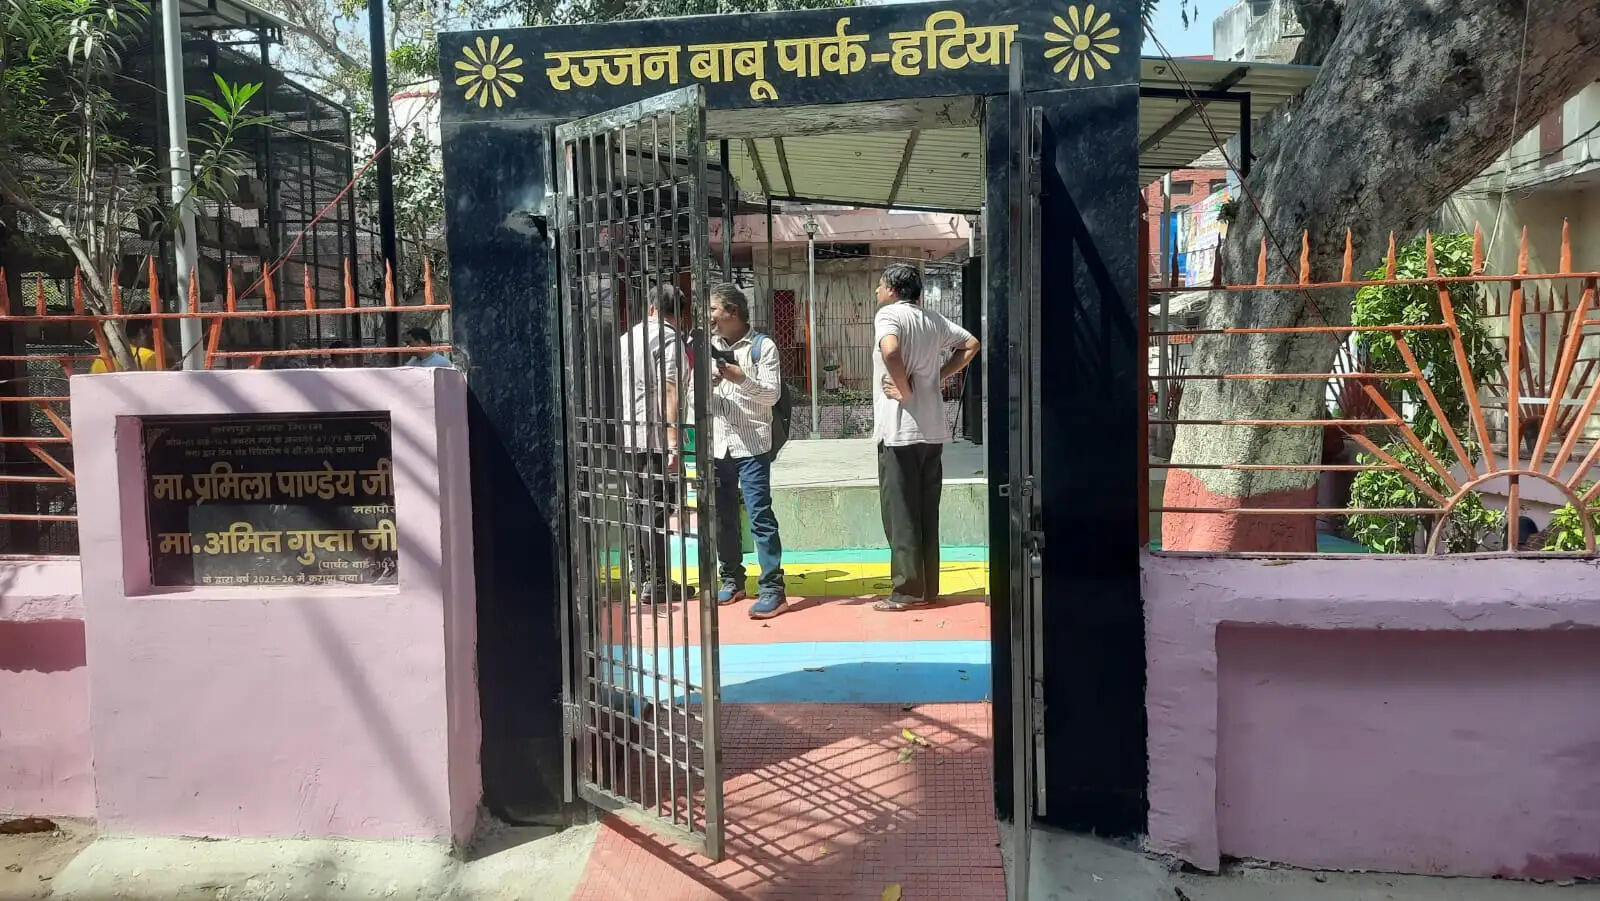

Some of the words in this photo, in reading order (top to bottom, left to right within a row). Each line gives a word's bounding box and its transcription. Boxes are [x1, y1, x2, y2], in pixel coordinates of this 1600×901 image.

[544, 45, 681, 91] रज्जन
[688, 40, 778, 100] बाबू
[775, 11, 1019, 78] पार्क-हटिया
[152, 461, 272, 506] मा.प्रमिला
[276, 460, 356, 500] पाण्डेय
[359, 458, 394, 496] जी
[158, 522, 282, 555] मा.अमित
[286, 530, 355, 566] गुप्ता
[359, 519, 397, 552] जी
[253, 575, 294, 584] 2025-26
